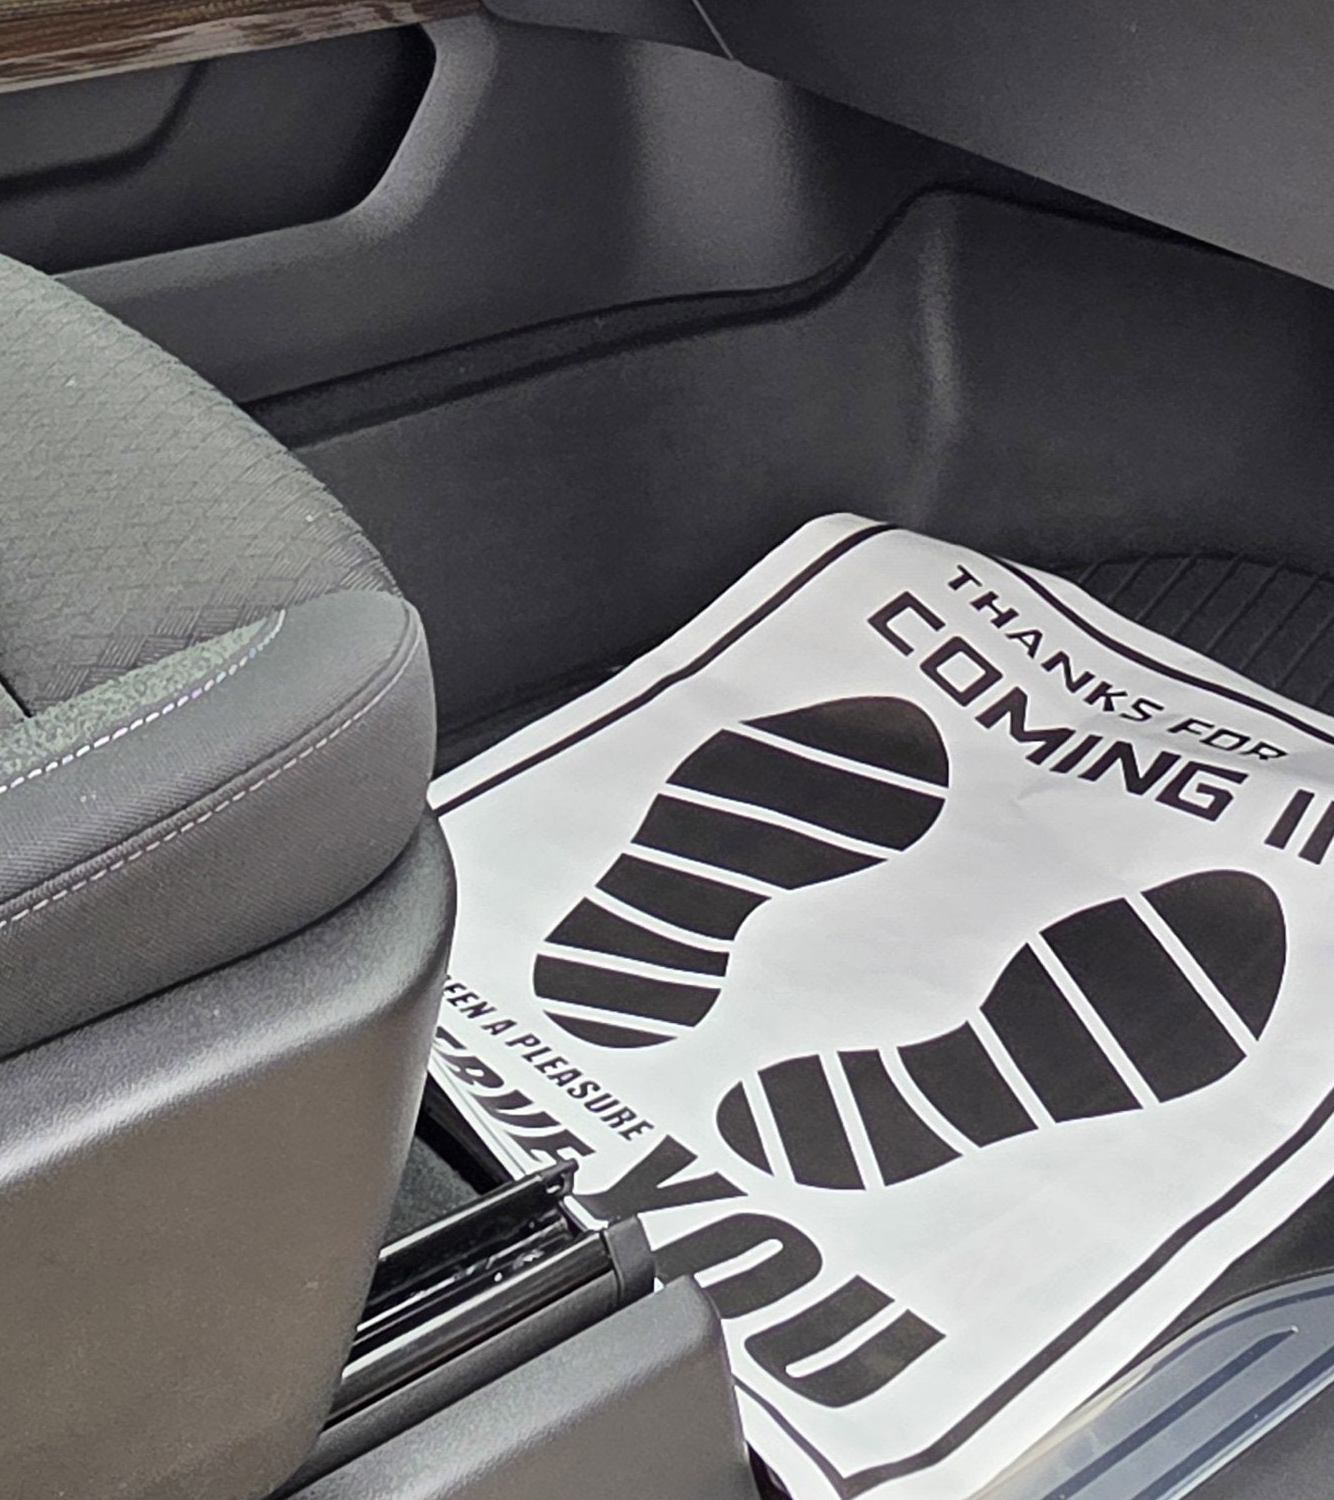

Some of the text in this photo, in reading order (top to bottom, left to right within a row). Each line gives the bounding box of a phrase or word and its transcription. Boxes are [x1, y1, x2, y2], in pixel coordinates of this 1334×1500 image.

[867, 591, 1250, 822] COMING
[947, 564, 1288, 762] THANKS FOR
[442, 974, 655, 1142] EEN A PLEASURE
[572, 1133, 947, 1409] YOU
